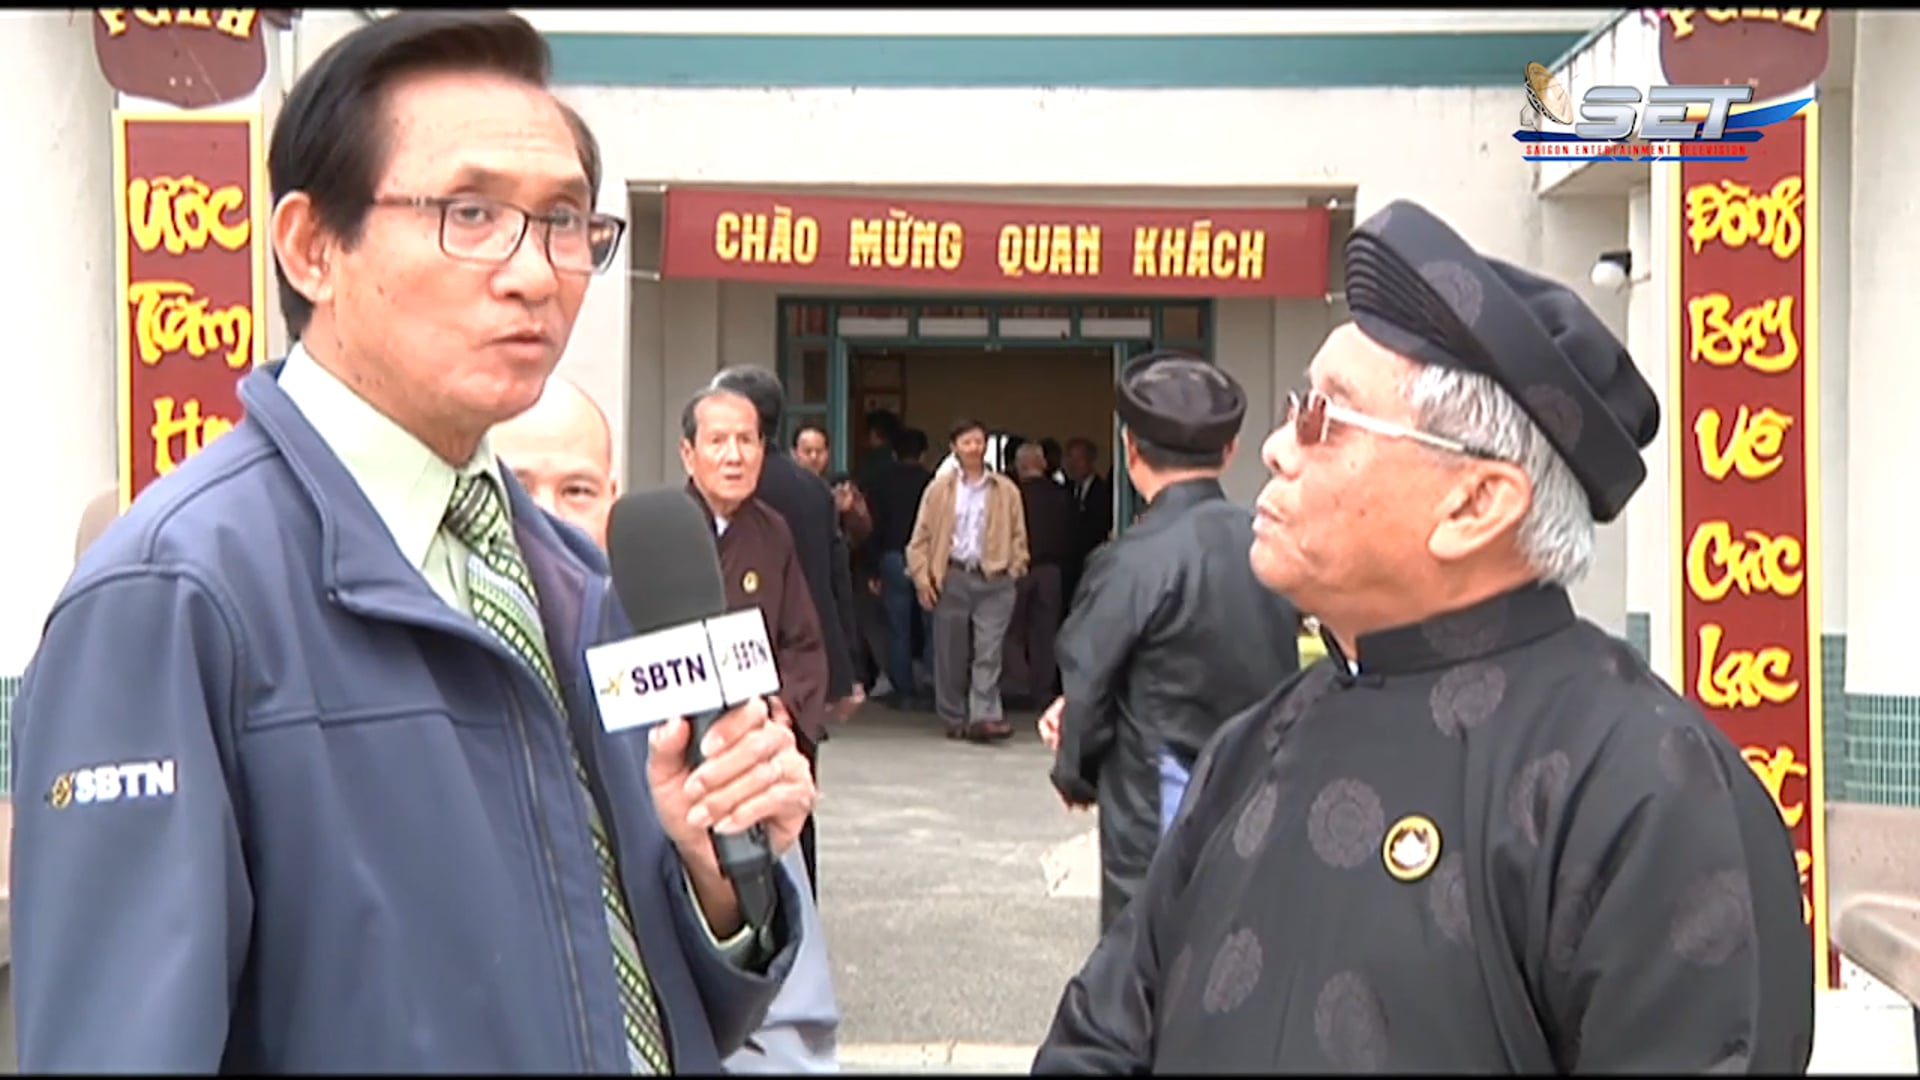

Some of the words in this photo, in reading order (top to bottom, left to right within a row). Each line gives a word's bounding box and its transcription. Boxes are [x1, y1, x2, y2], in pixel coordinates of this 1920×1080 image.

[715, 204, 819, 264] CHÀO
[849, 207, 962, 270] MỪNG
[997, 223, 1101, 277] QUAN
[1132, 219, 1266, 280] KHÁCH
[631, 653, 707, 697] SBTN
[74, 758, 176, 804] SBTN
